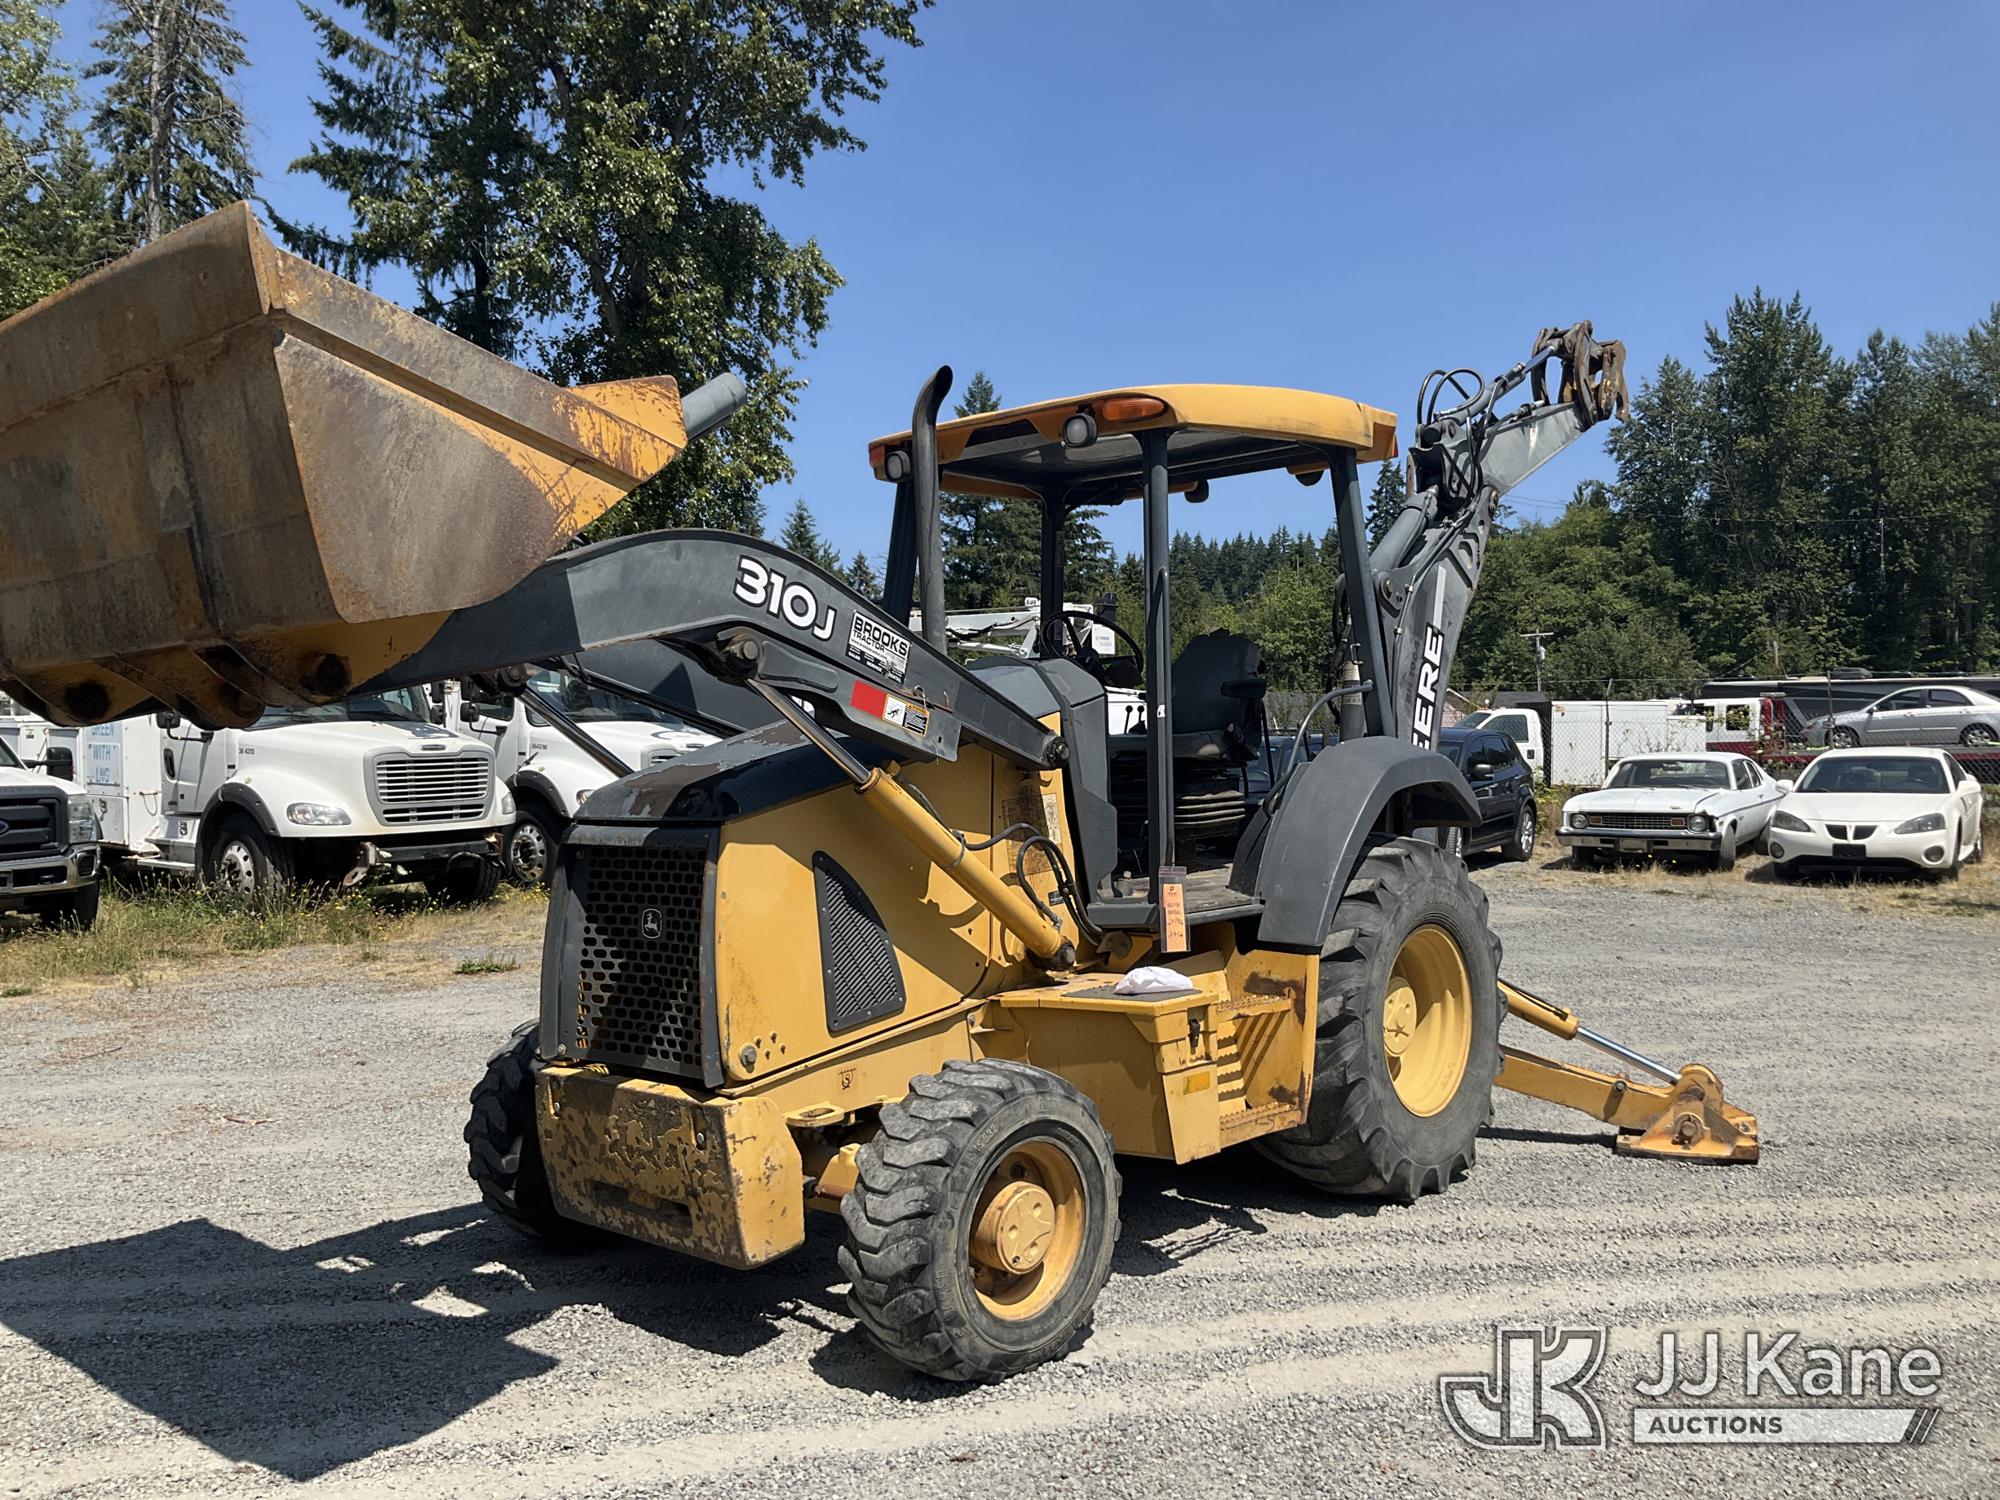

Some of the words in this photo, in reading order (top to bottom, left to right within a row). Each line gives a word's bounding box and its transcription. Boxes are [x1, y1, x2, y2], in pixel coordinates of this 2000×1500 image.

[733, 555, 838, 641] 310J
[853, 616, 908, 656] BROOKS
[853, 630, 885, 653] TRACTOR
[1412, 625, 1444, 750] ERE
[95, 767, 110, 782] LNG
